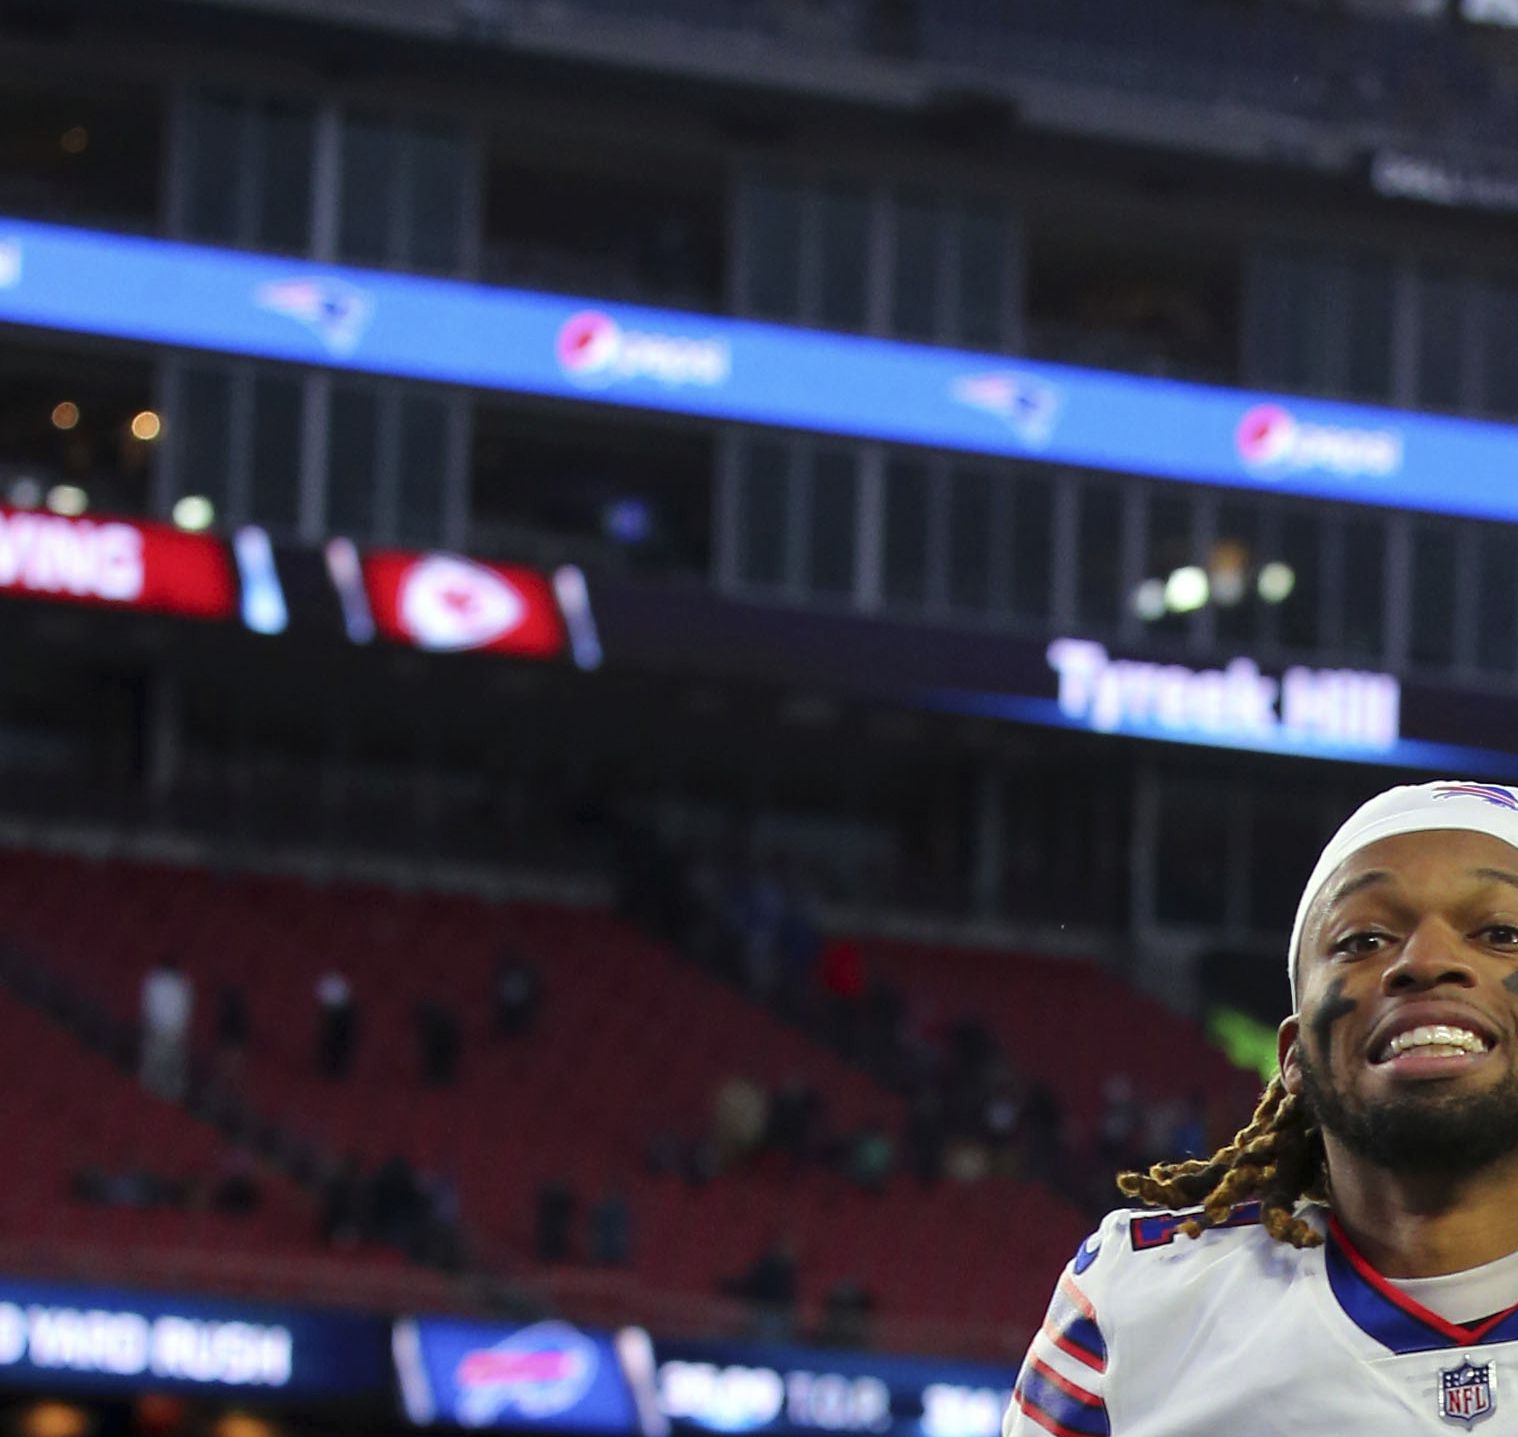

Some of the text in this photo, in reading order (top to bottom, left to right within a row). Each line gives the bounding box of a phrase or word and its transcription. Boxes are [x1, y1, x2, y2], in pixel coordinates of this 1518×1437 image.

[1046, 637, 1399, 749] Tyreek Hill
[1448, 1386, 1487, 1414] NFL
